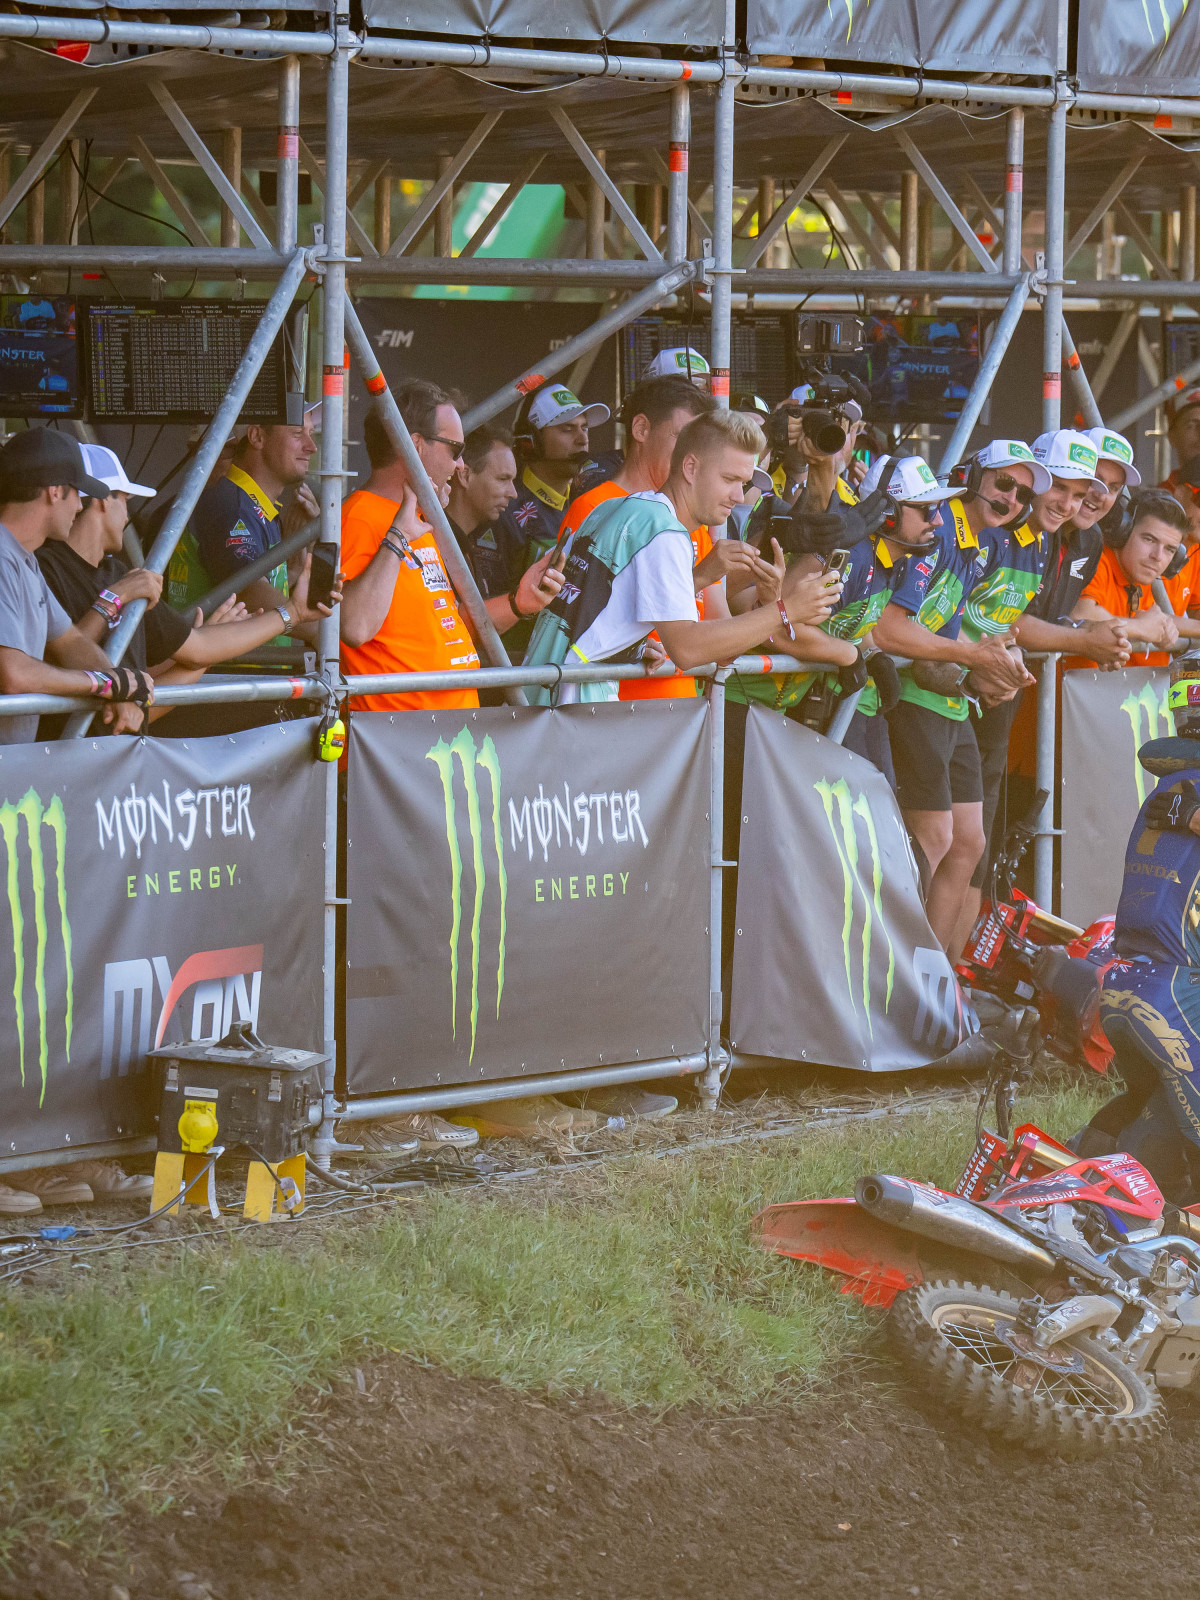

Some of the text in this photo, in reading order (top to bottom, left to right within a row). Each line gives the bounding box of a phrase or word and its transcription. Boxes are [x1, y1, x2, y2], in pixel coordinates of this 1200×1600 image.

[127, 864, 238, 898] ENERGY
[535, 871, 630, 902] ENERGY
[1098, 1157, 1138, 1172] HONDA
